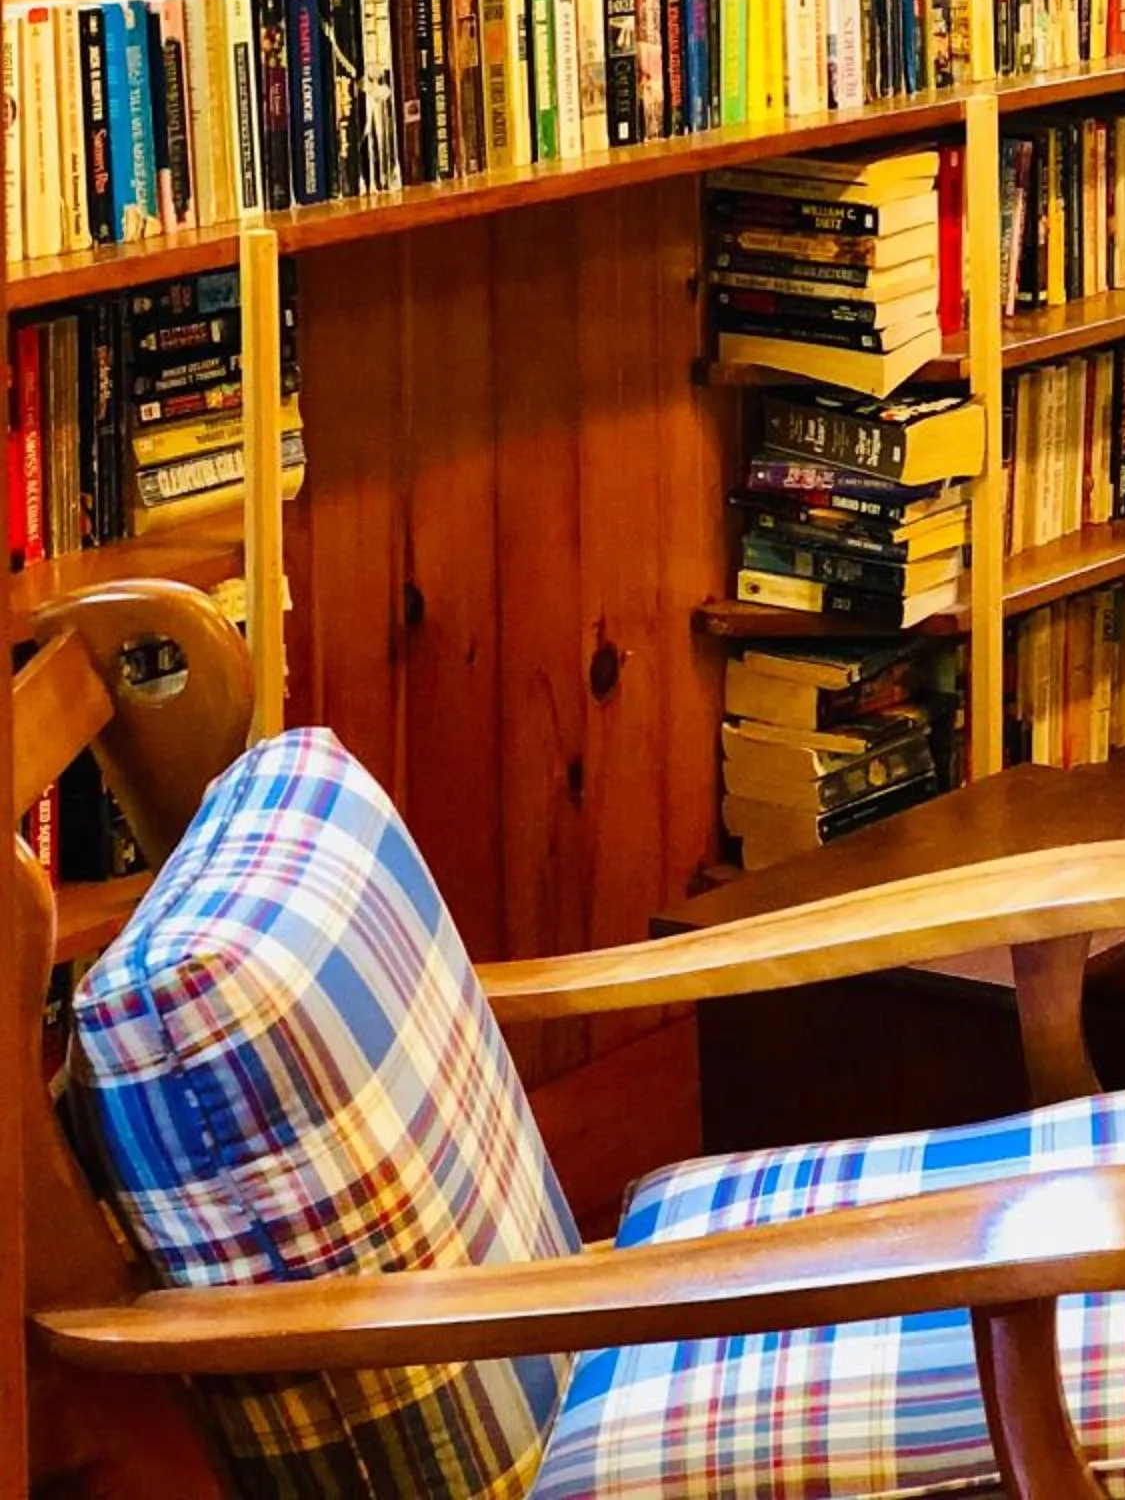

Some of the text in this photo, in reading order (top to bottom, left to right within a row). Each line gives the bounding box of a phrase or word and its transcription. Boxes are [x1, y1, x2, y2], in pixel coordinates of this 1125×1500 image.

[562, 13, 575, 124] PETER BENCHLEY
[801, 204, 845, 221] WILLIAM
[814, 216, 842, 231] DIETZ
[24, 431, 40, 543] SWISS ACCOUNT
